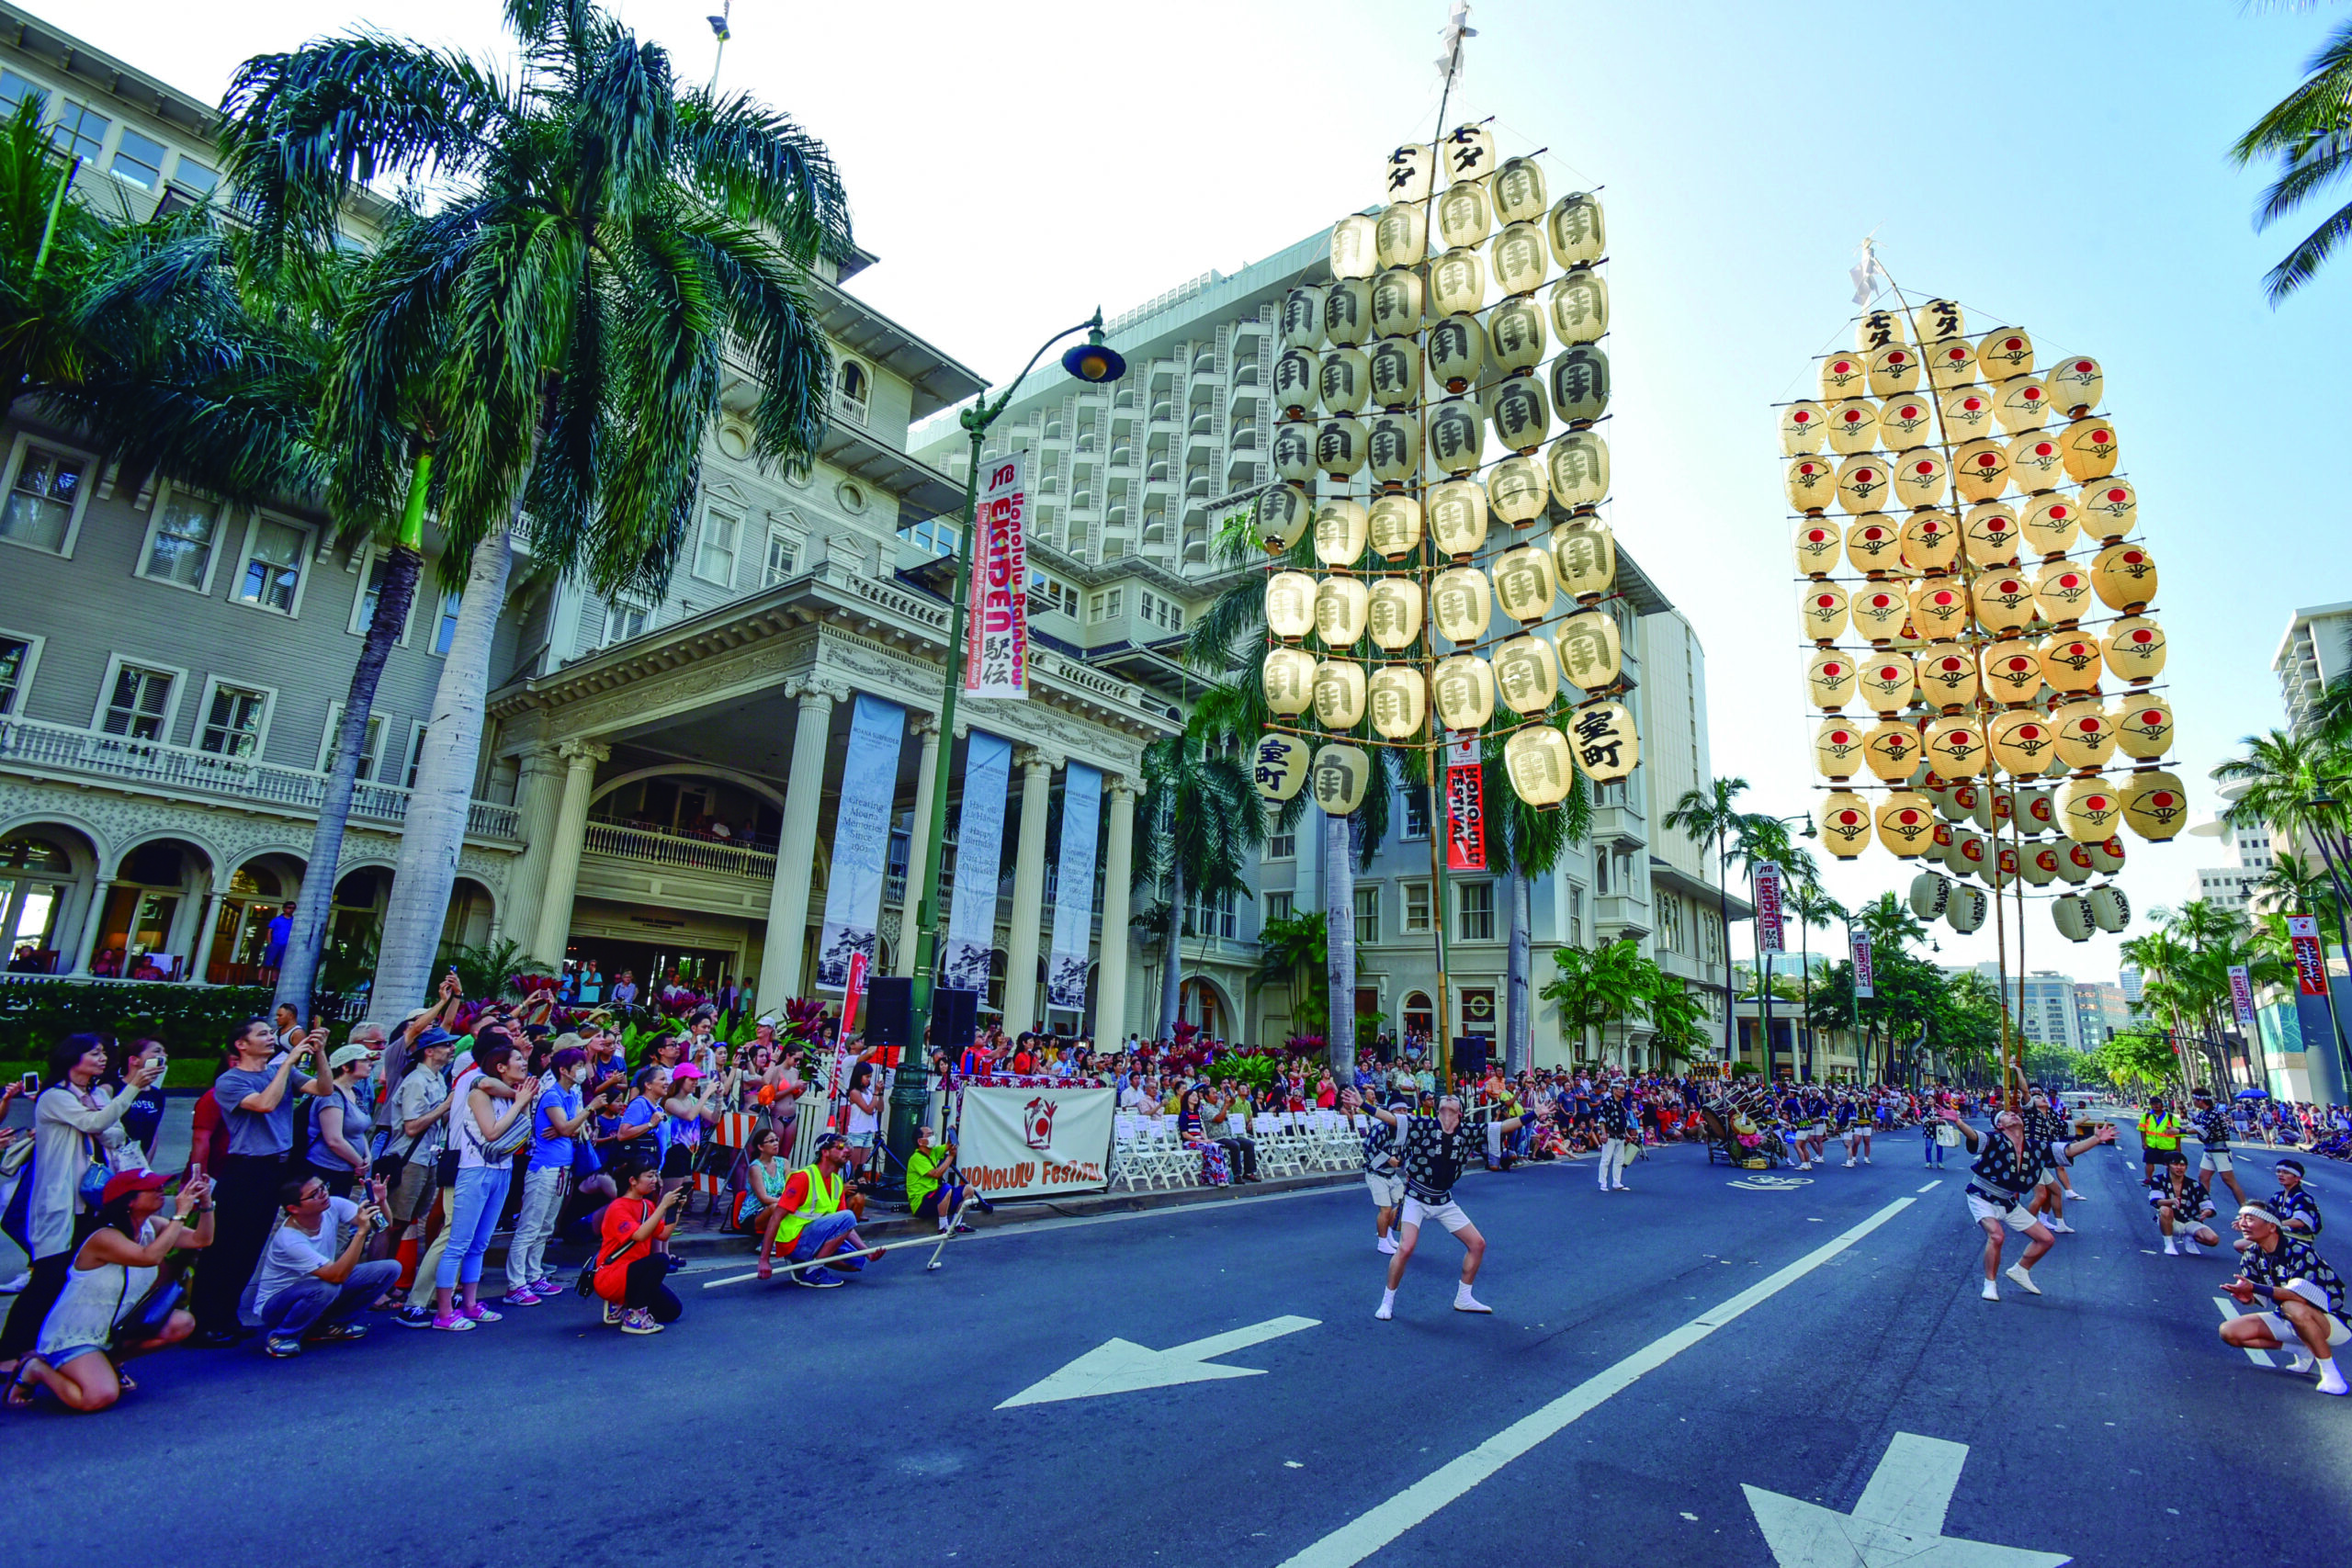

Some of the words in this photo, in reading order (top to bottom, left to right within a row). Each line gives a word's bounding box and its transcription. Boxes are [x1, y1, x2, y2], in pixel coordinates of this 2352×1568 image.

[1448, 127, 1484, 173] 七夕
[1388, 147, 1417, 193] 七夕
[1866, 313, 1892, 351] 七夕
[1932, 301, 1958, 337] 七夕
[989, 464, 1015, 491] JTB
[978, 525, 988, 557] Rainbow
[1011, 492, 1026, 585] Honolulu
[977, 569, 985, 581] the
[978, 559, 986, 568] of
[972, 612, 983, 641] Joining
[1012, 593, 1026, 686] Rainbow
[972, 643, 981, 660] with
[982, 636, 1012, 685] 駅伝
[1576, 710, 1623, 768] 室町
[1255, 739, 1291, 792] 室町
[849, 795, 884, 812] Creating
[850, 807, 878, 821] Moana
[1452, 768, 1464, 845] FESTIVAL
[1466, 767, 1481, 864] HONOLULU
[843, 818, 883, 833] Memories
[849, 830, 872, 841] Since
[970, 826, 992, 840] Happy
[1758, 865, 1773, 874] JTB
[2305, 937, 2324, 992] HONOLULU
